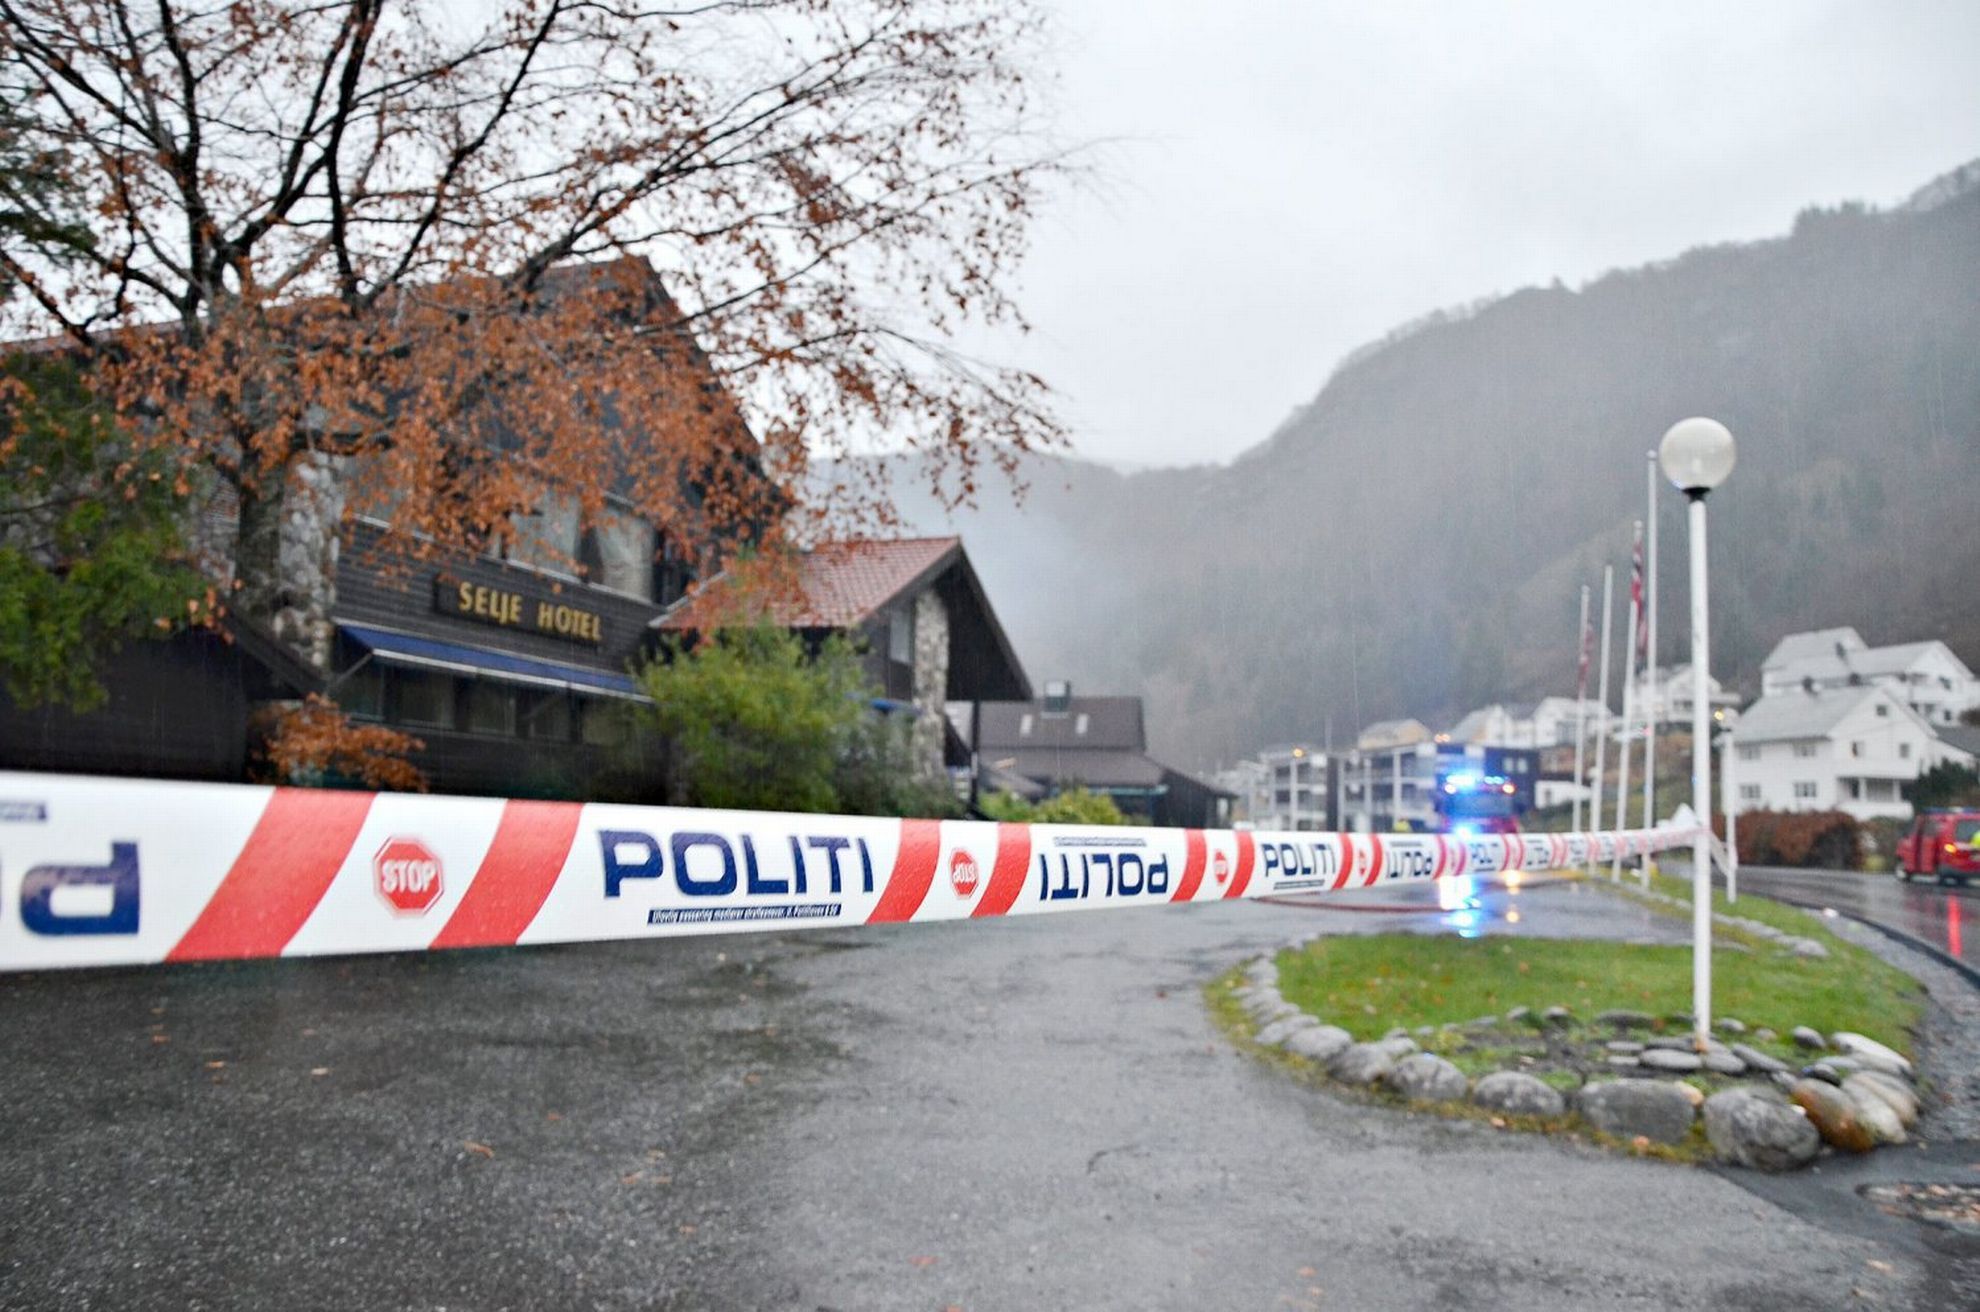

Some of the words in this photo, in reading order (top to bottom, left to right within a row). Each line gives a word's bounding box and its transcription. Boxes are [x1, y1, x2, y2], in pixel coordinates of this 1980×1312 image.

[459, 582, 522, 624] SELJE
[538, 602, 601, 641] HOTEL
[382, 860, 438, 893] STOP
[600, 829, 874, 899] POLITI
[1039, 853, 1169, 900] POLITI
[1261, 843, 1337, 877] POLITI
[0, 841, 141, 938] P
